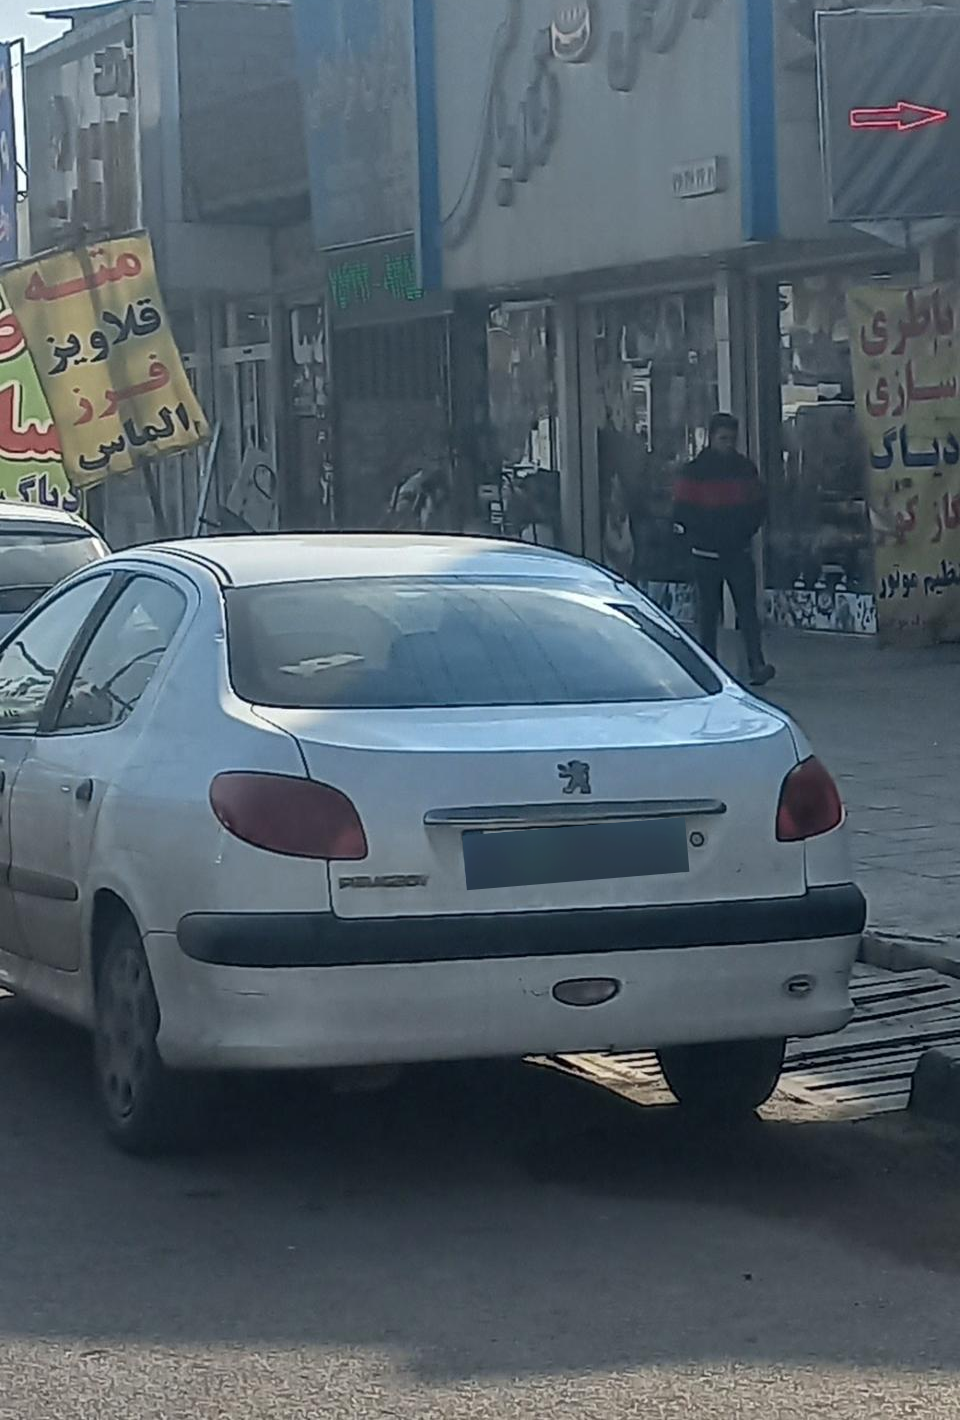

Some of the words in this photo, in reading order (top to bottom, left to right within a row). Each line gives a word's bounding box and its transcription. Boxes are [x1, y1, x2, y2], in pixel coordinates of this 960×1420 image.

[25, 247, 142, 301] مته
[46, 297, 162, 377] قلاویز
[861, 288, 954, 356] باطری
[73, 353, 171, 426] فرز
[866, 359, 958, 418] سازی
[78, 401, 190, 472] الماس
